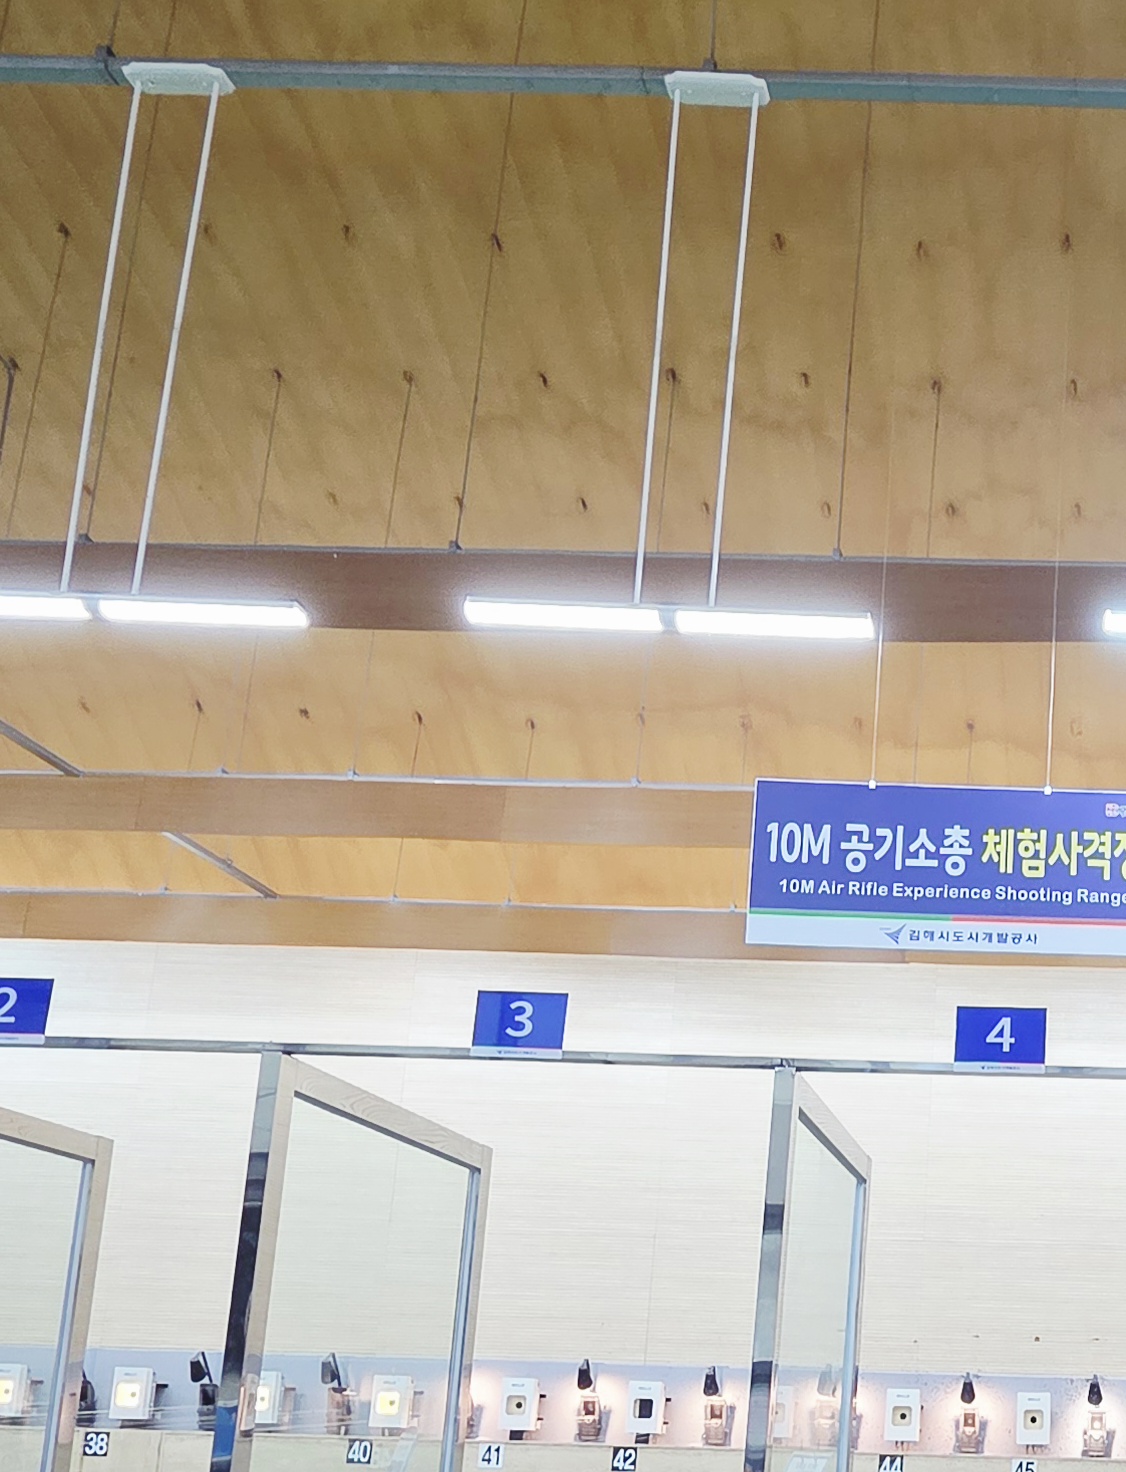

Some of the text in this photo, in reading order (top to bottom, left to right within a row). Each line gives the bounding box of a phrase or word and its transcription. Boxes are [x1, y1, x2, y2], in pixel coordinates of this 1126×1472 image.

[766, 822, 832, 865] 10M
[840, 823, 973, 877] 공기소총
[779, 879, 815, 894] 10M
[818, 880, 845, 895] Air
[849, 881, 889, 897] Rifle
[892, 883, 992, 901] Experience
[995, 885, 1073, 906] Shooting
[909, 929, 1038, 945] 김해시도시개발공사
[0, 986, 18, 1024] 2
[505, 1000, 534, 1038] 3
[985, 1016, 1016, 1053] 4
[84, 1432, 108, 1455] 38
[347, 1440, 371, 1463] 40
[481, 1444, 501, 1466] 41
[612, 1447, 636, 1470] 42
